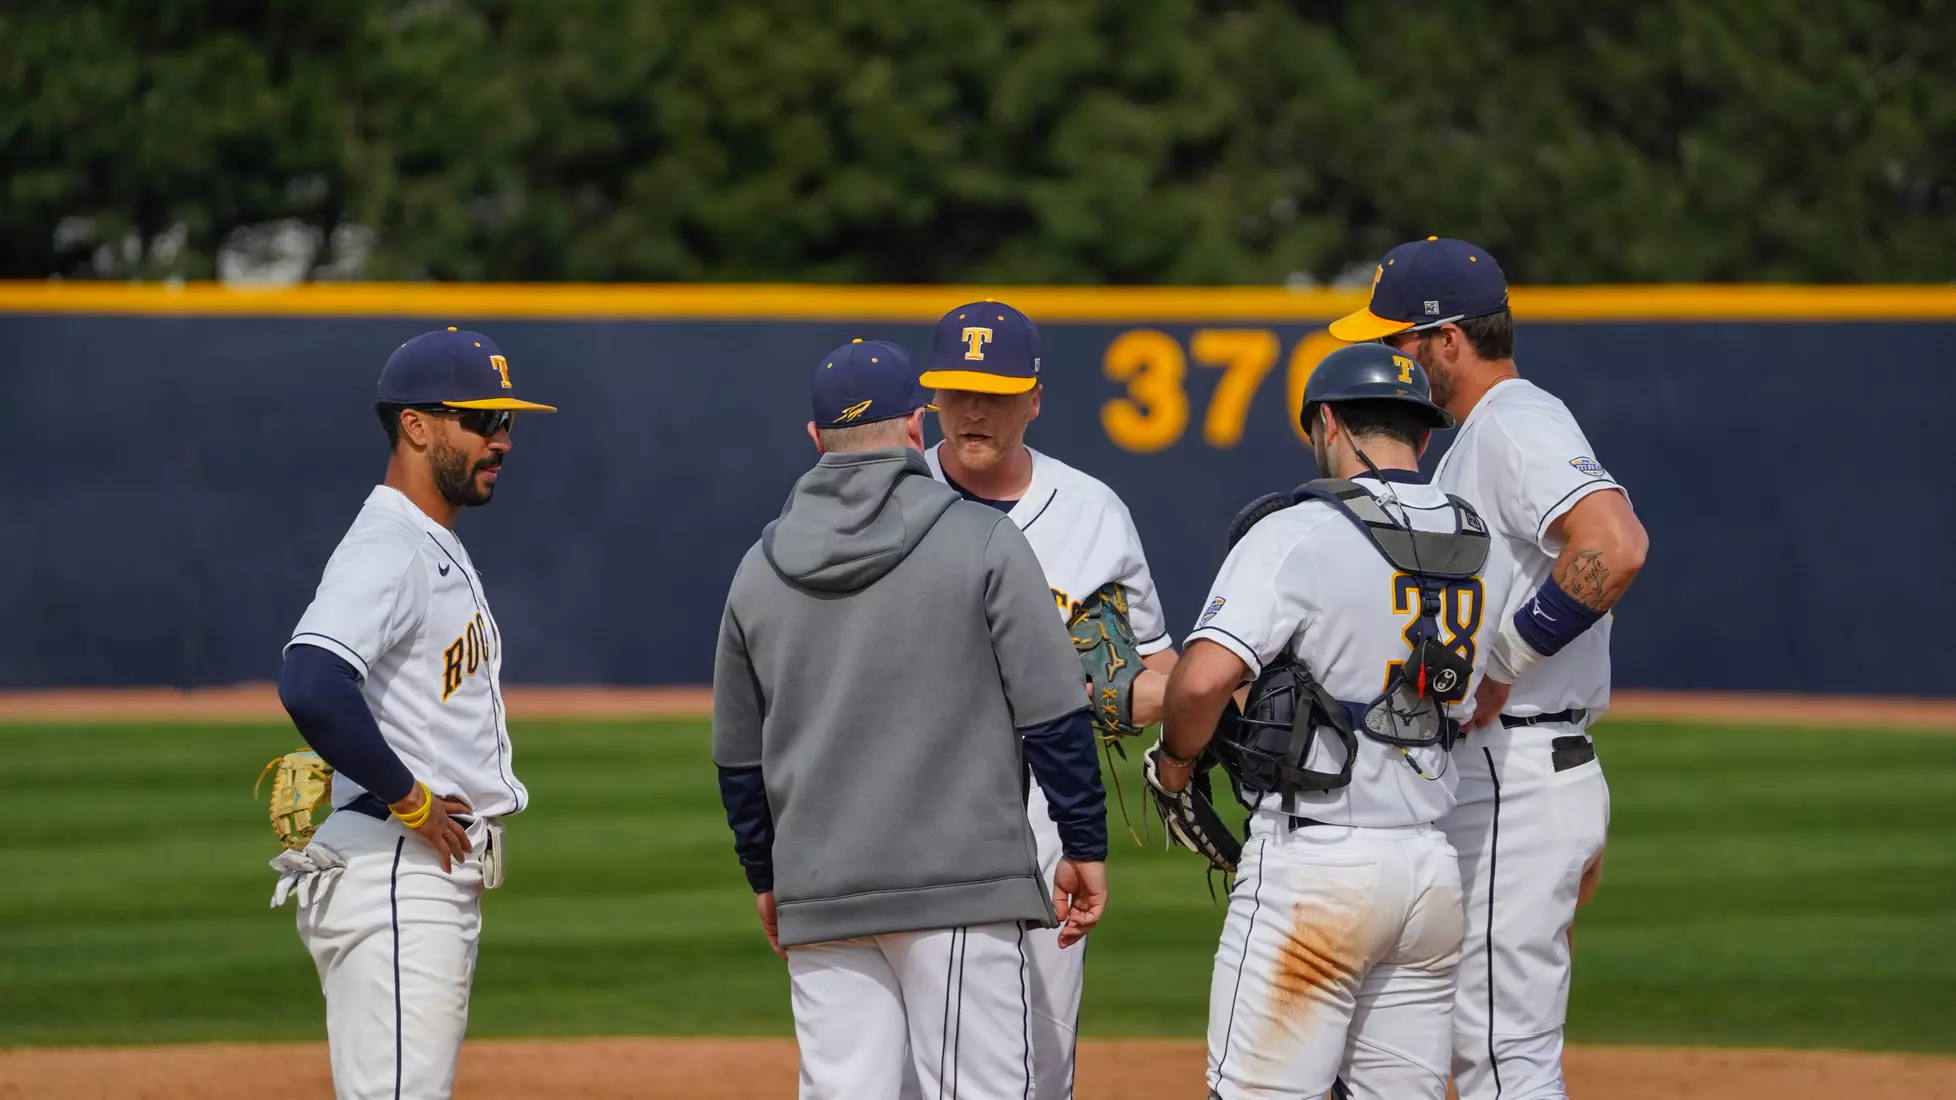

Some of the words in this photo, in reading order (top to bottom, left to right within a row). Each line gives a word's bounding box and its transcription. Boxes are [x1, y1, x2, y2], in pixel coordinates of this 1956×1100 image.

[961, 327, 993, 361] T
[490, 355, 513, 389] T
[1393, 355, 1415, 384] T
